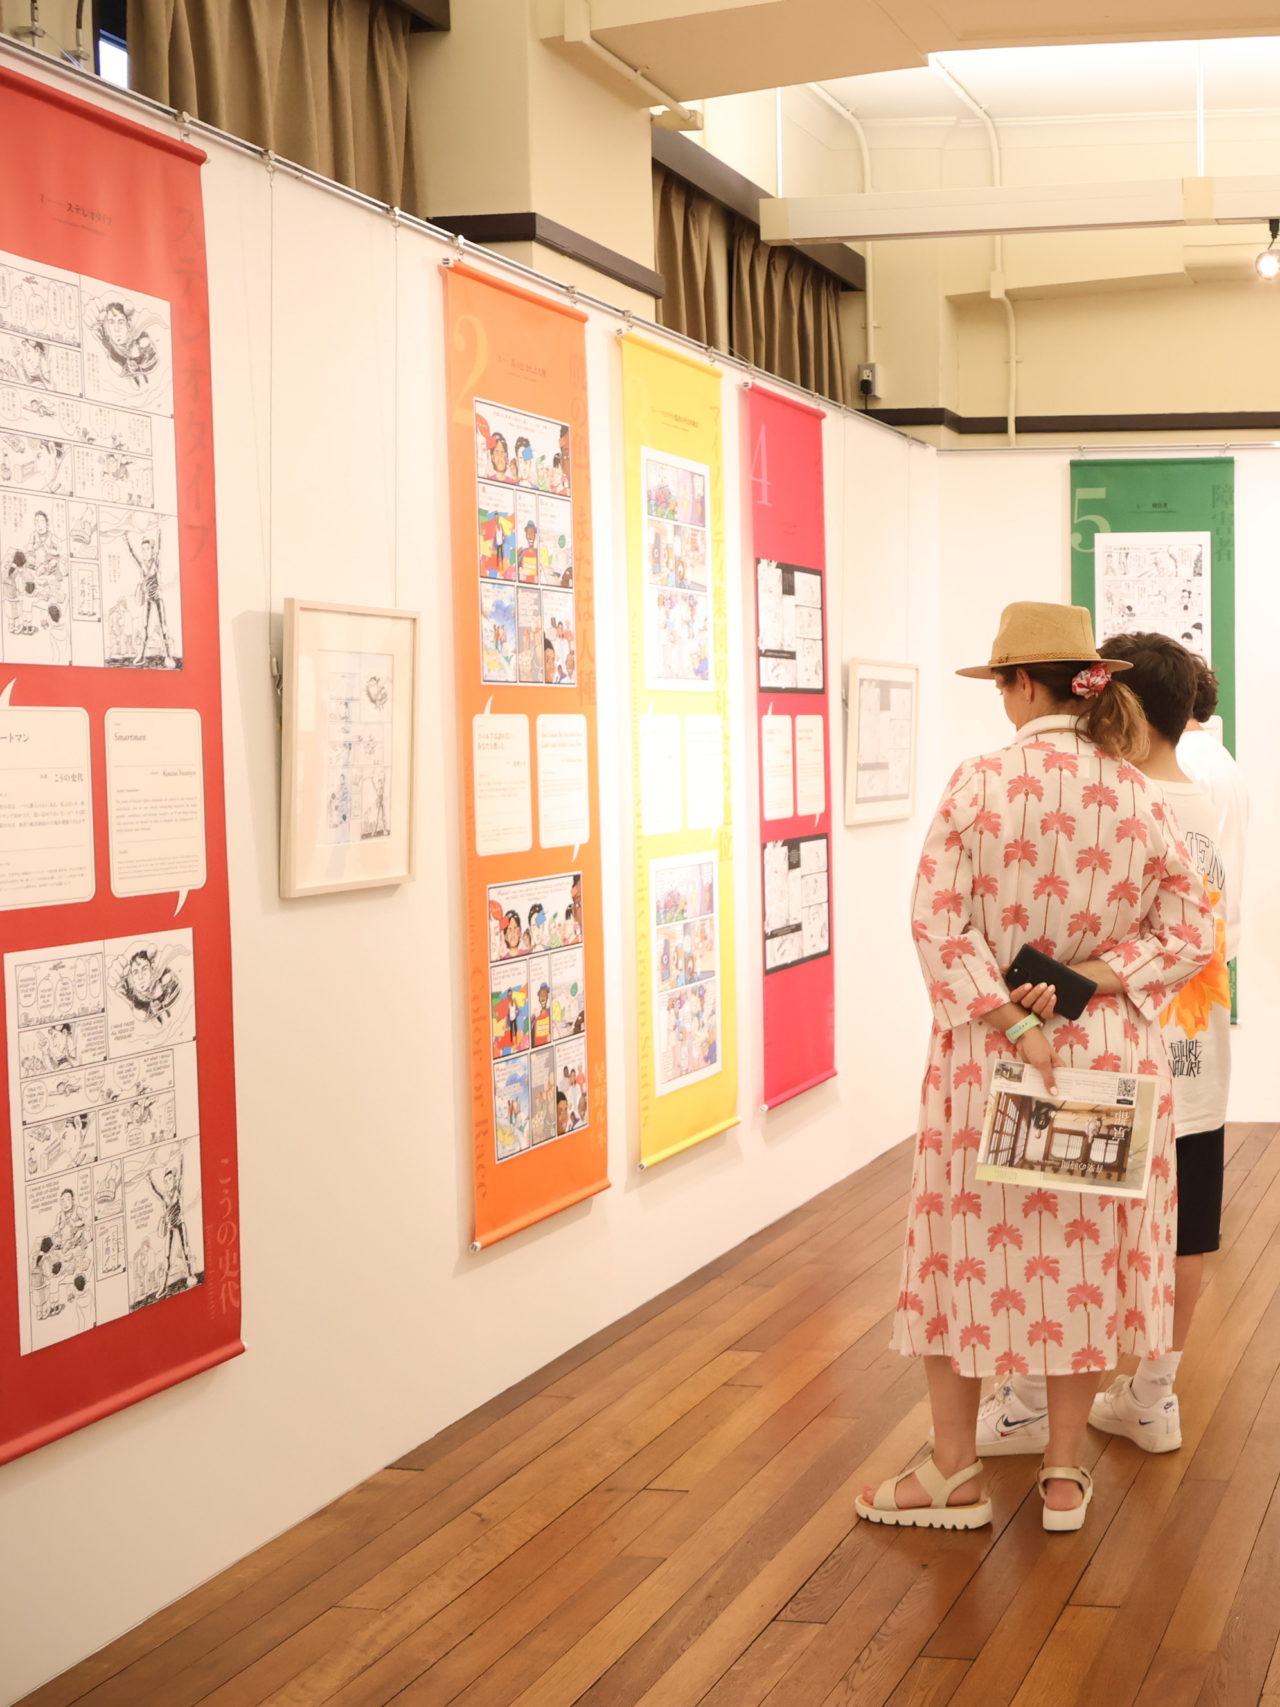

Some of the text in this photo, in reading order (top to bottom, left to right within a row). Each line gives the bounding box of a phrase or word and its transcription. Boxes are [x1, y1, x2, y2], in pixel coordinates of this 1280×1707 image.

[452, 313, 489, 425] 2
[751, 424, 773, 507] 4
[1071, 487, 1111, 553] 5
[1169, 1039, 1202, 1062] FUTURE
[1112, 1110, 1131, 1142] 京都
[1060, 1159, 1104, 1174] 音楽の時間
[216, 1158, 241, 1314] こうの史代
